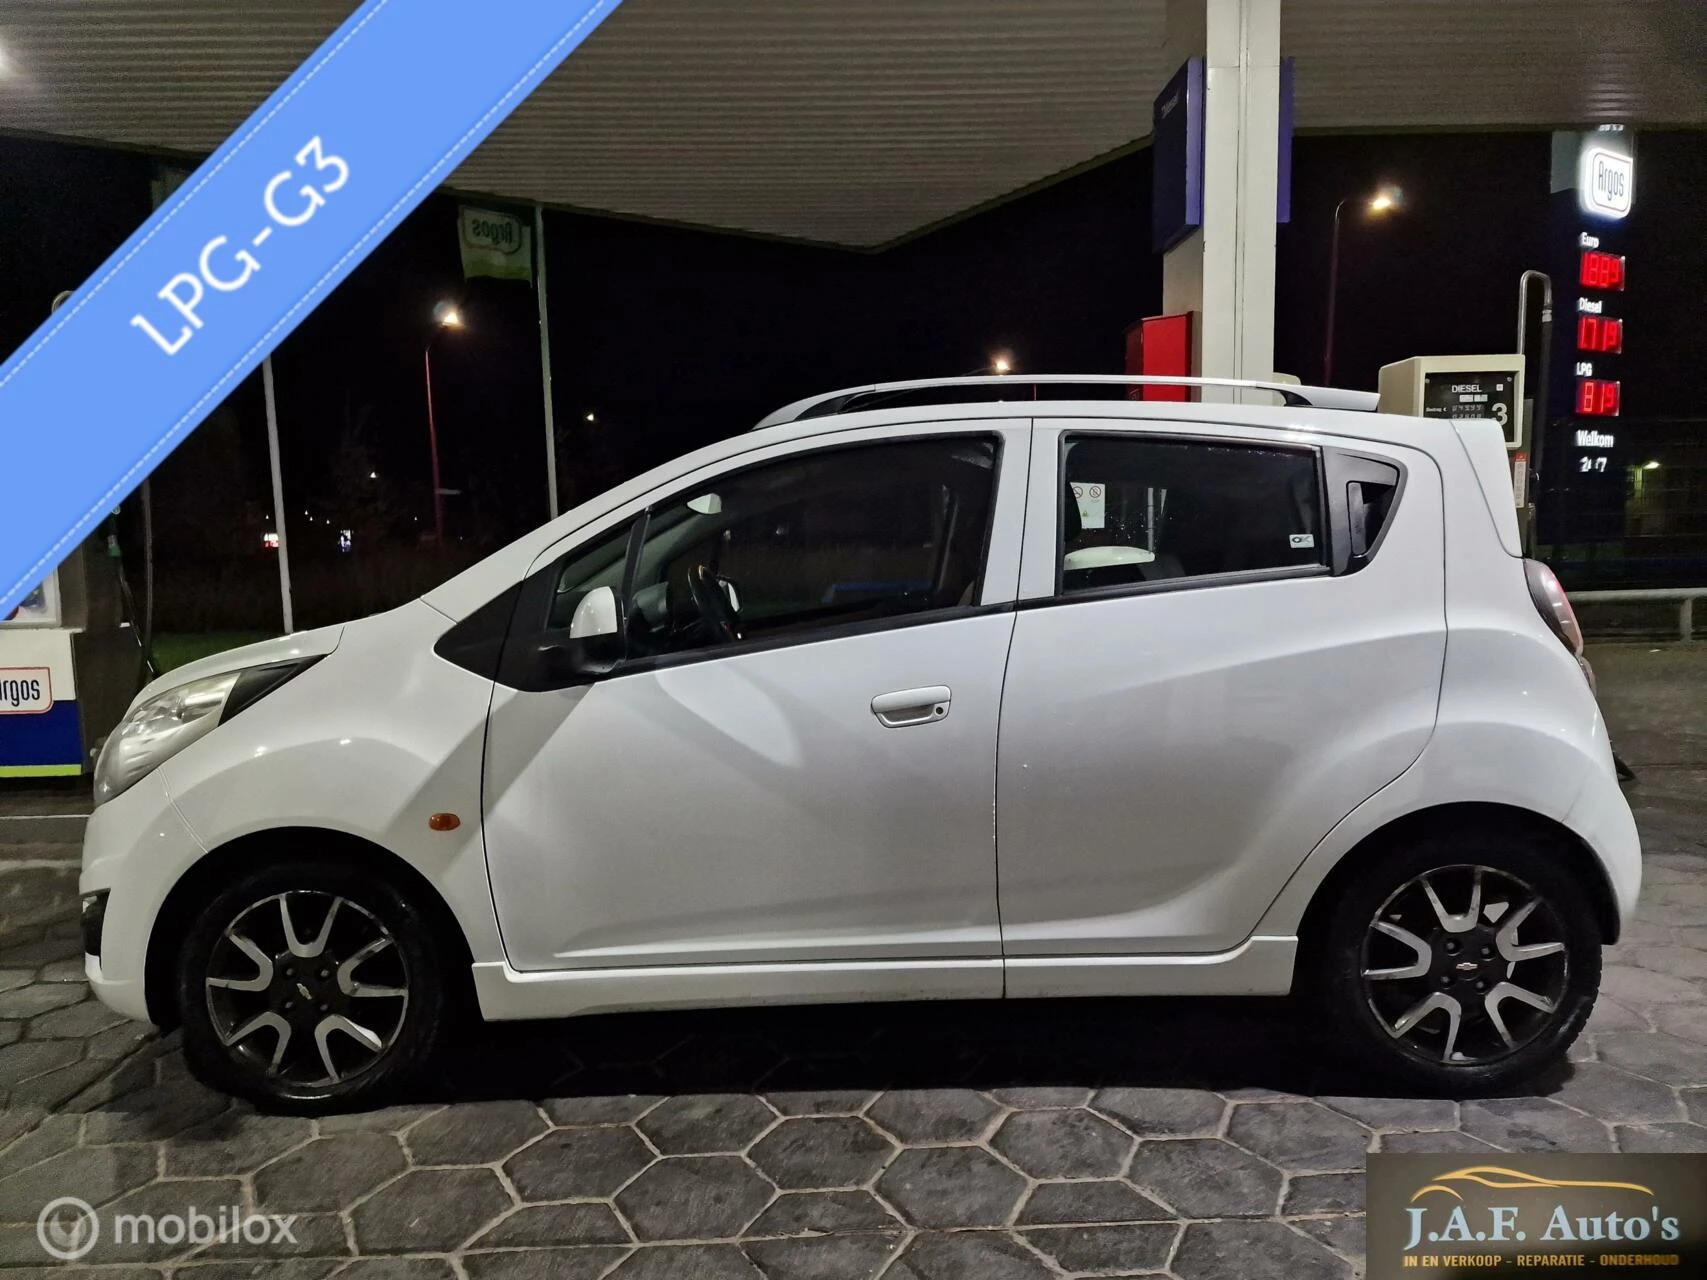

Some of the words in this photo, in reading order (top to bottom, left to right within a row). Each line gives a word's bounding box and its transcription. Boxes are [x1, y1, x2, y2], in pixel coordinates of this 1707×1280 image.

[1597, 160, 1625, 201] Argos
[1580, 231, 1600, 248] Euro
[1578, 297, 1603, 314] Diesel
[1576, 362, 1593, 376] LPG
[1451, 384, 1483, 393] DIESEL
[1491, 402, 1509, 426] 3
[1576, 430, 1614, 447] Welkom
